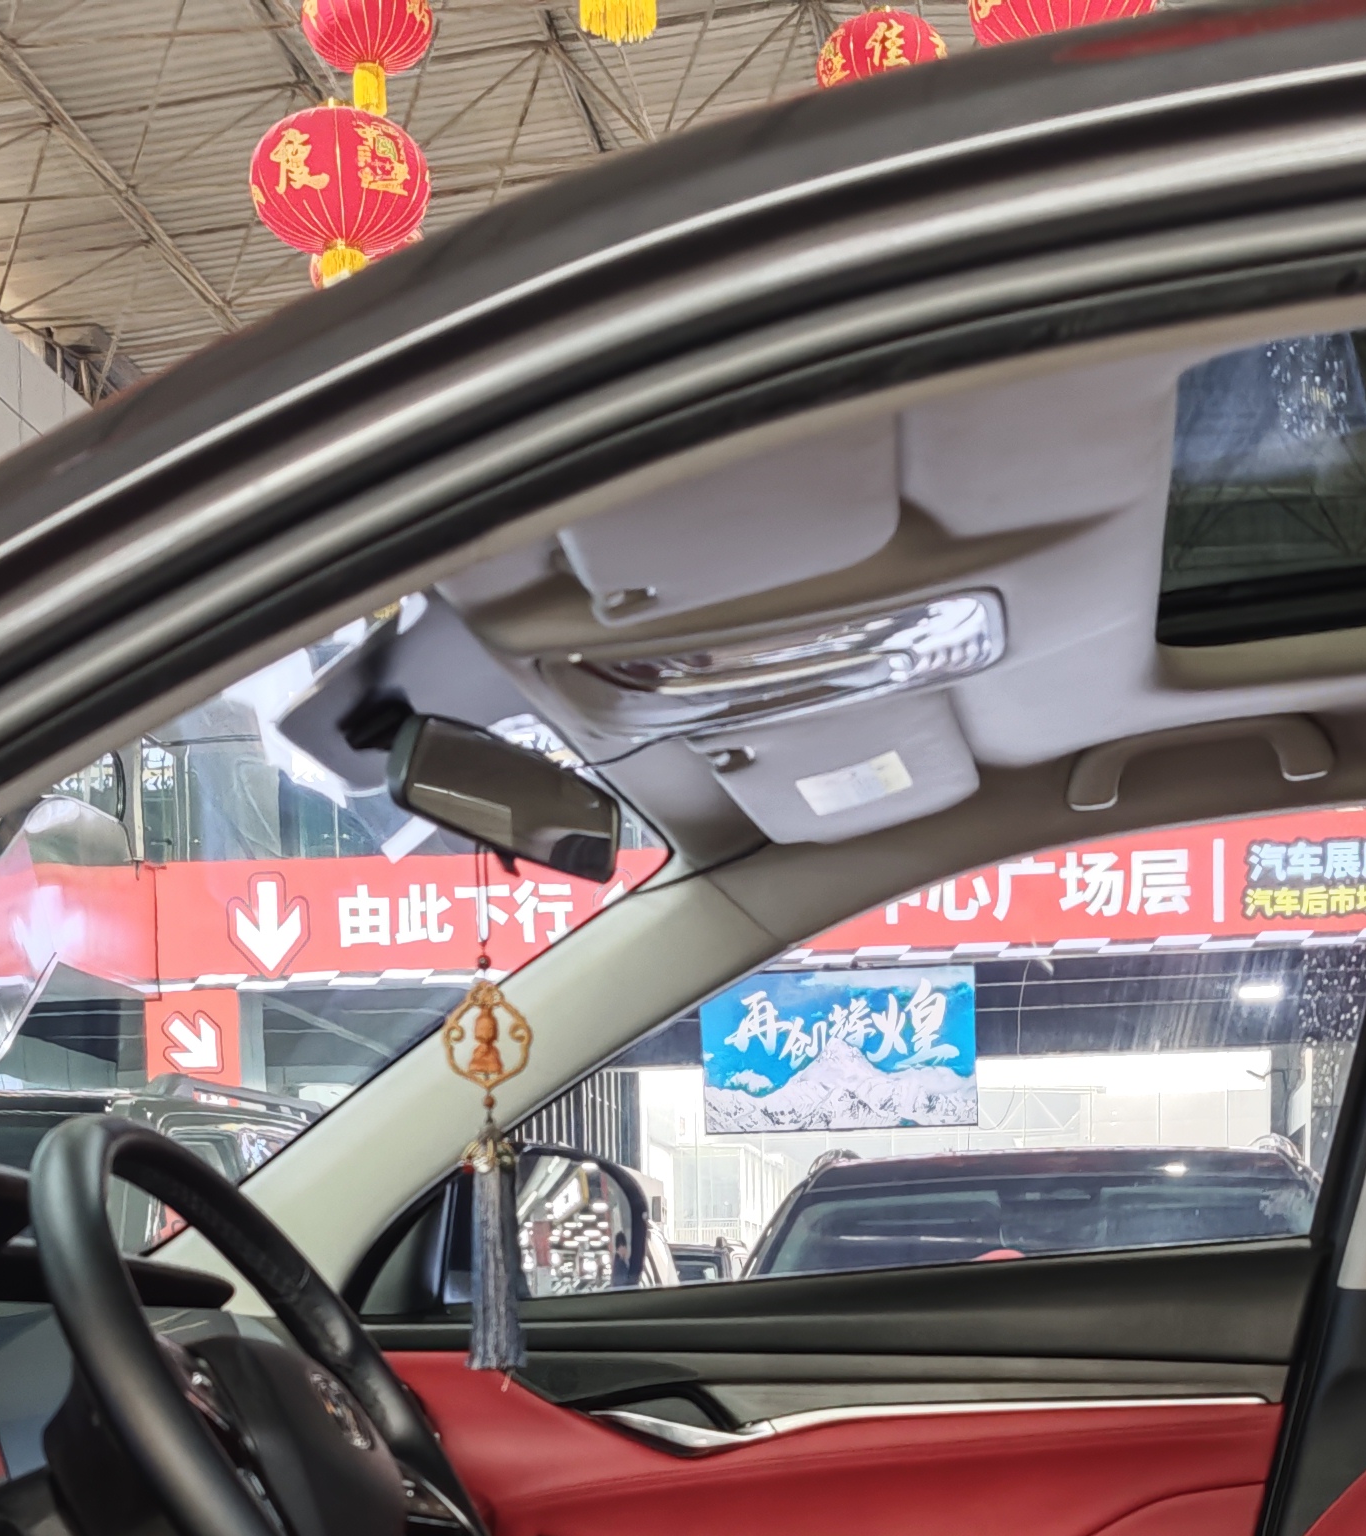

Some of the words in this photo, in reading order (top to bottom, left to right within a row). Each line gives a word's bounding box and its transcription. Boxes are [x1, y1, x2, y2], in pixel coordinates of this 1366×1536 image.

[338, 879, 574, 948] 由此下行
[724, 978, 961, 1070] 再创辉煌
